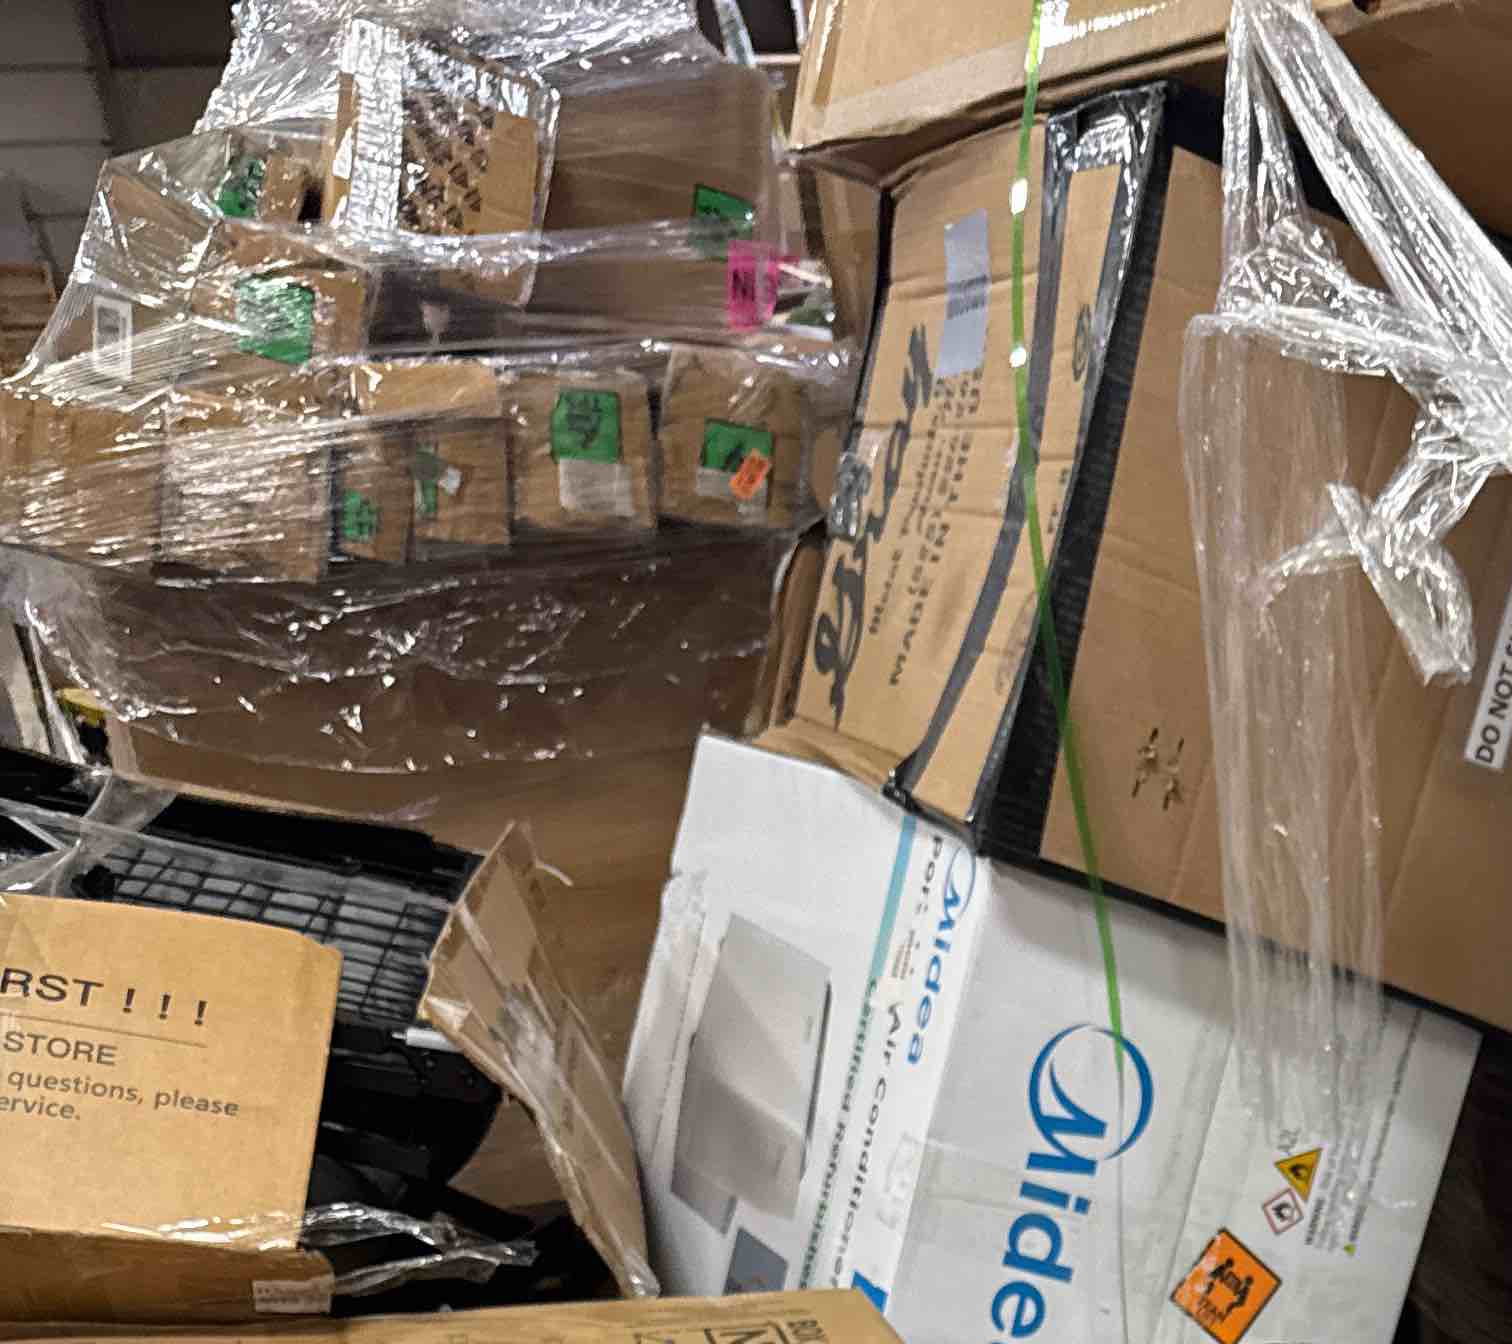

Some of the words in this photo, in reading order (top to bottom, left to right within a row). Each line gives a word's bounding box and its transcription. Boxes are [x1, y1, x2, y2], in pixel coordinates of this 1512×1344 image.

[1474, 723, 1503, 764] DO
[908, 868, 968, 1064] Midea
[3, 1030, 118, 1066] STORE
[7, 1070, 143, 1105] questions,
[153, 1089, 240, 1117] please
